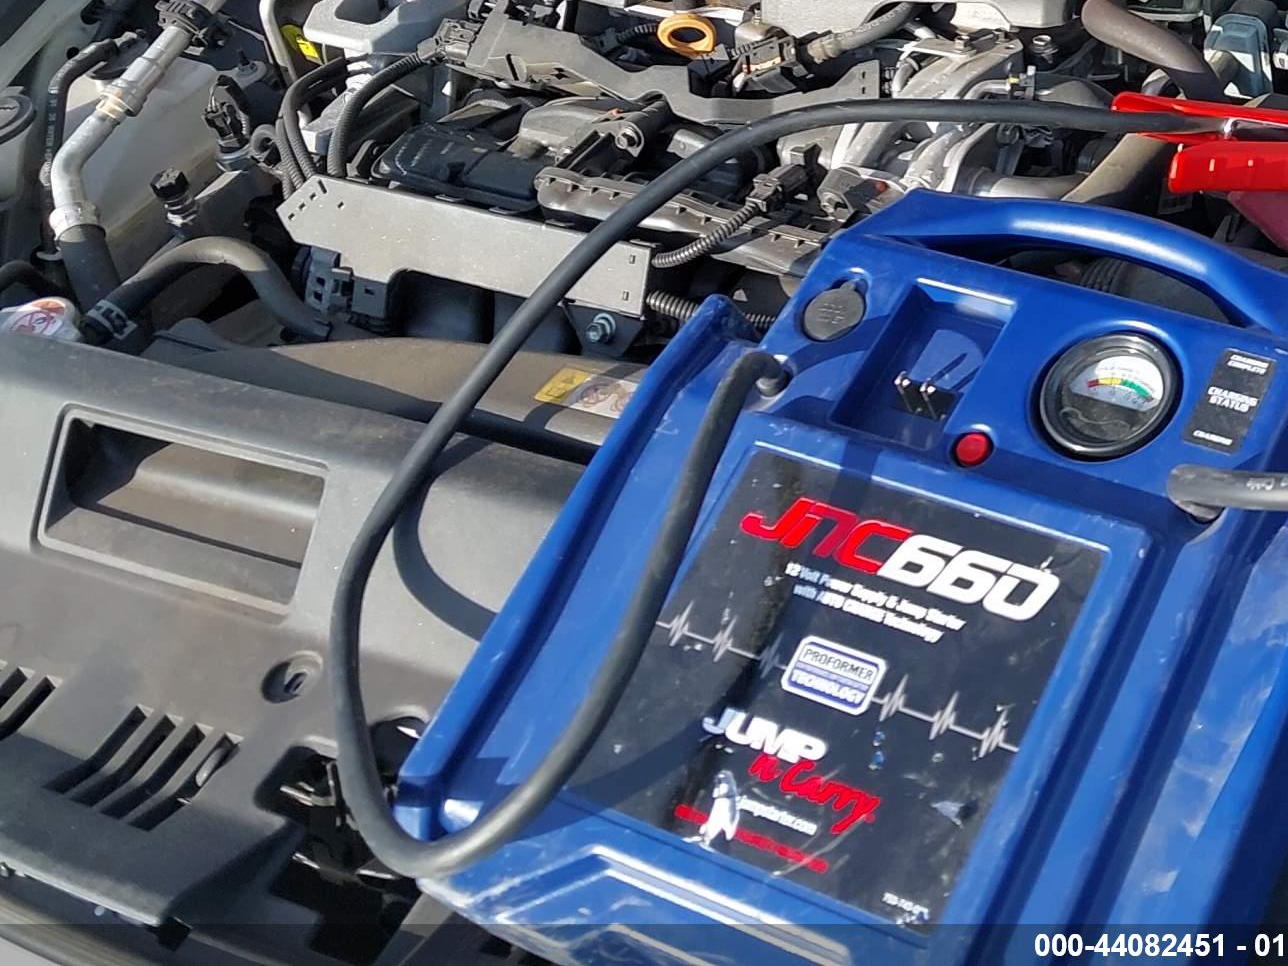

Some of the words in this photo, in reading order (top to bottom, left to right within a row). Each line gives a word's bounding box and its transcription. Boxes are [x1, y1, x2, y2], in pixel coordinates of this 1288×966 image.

[1207, 386, 1259, 407] CHARGING
[1208, 395, 1250, 413] STATUS
[739, 497, 1061, 621] JNC660
[802, 648, 874, 681] PROFORMER
[790, 670, 866, 704] TECHNOLOGY
[702, 707, 828, 763] JUMP
